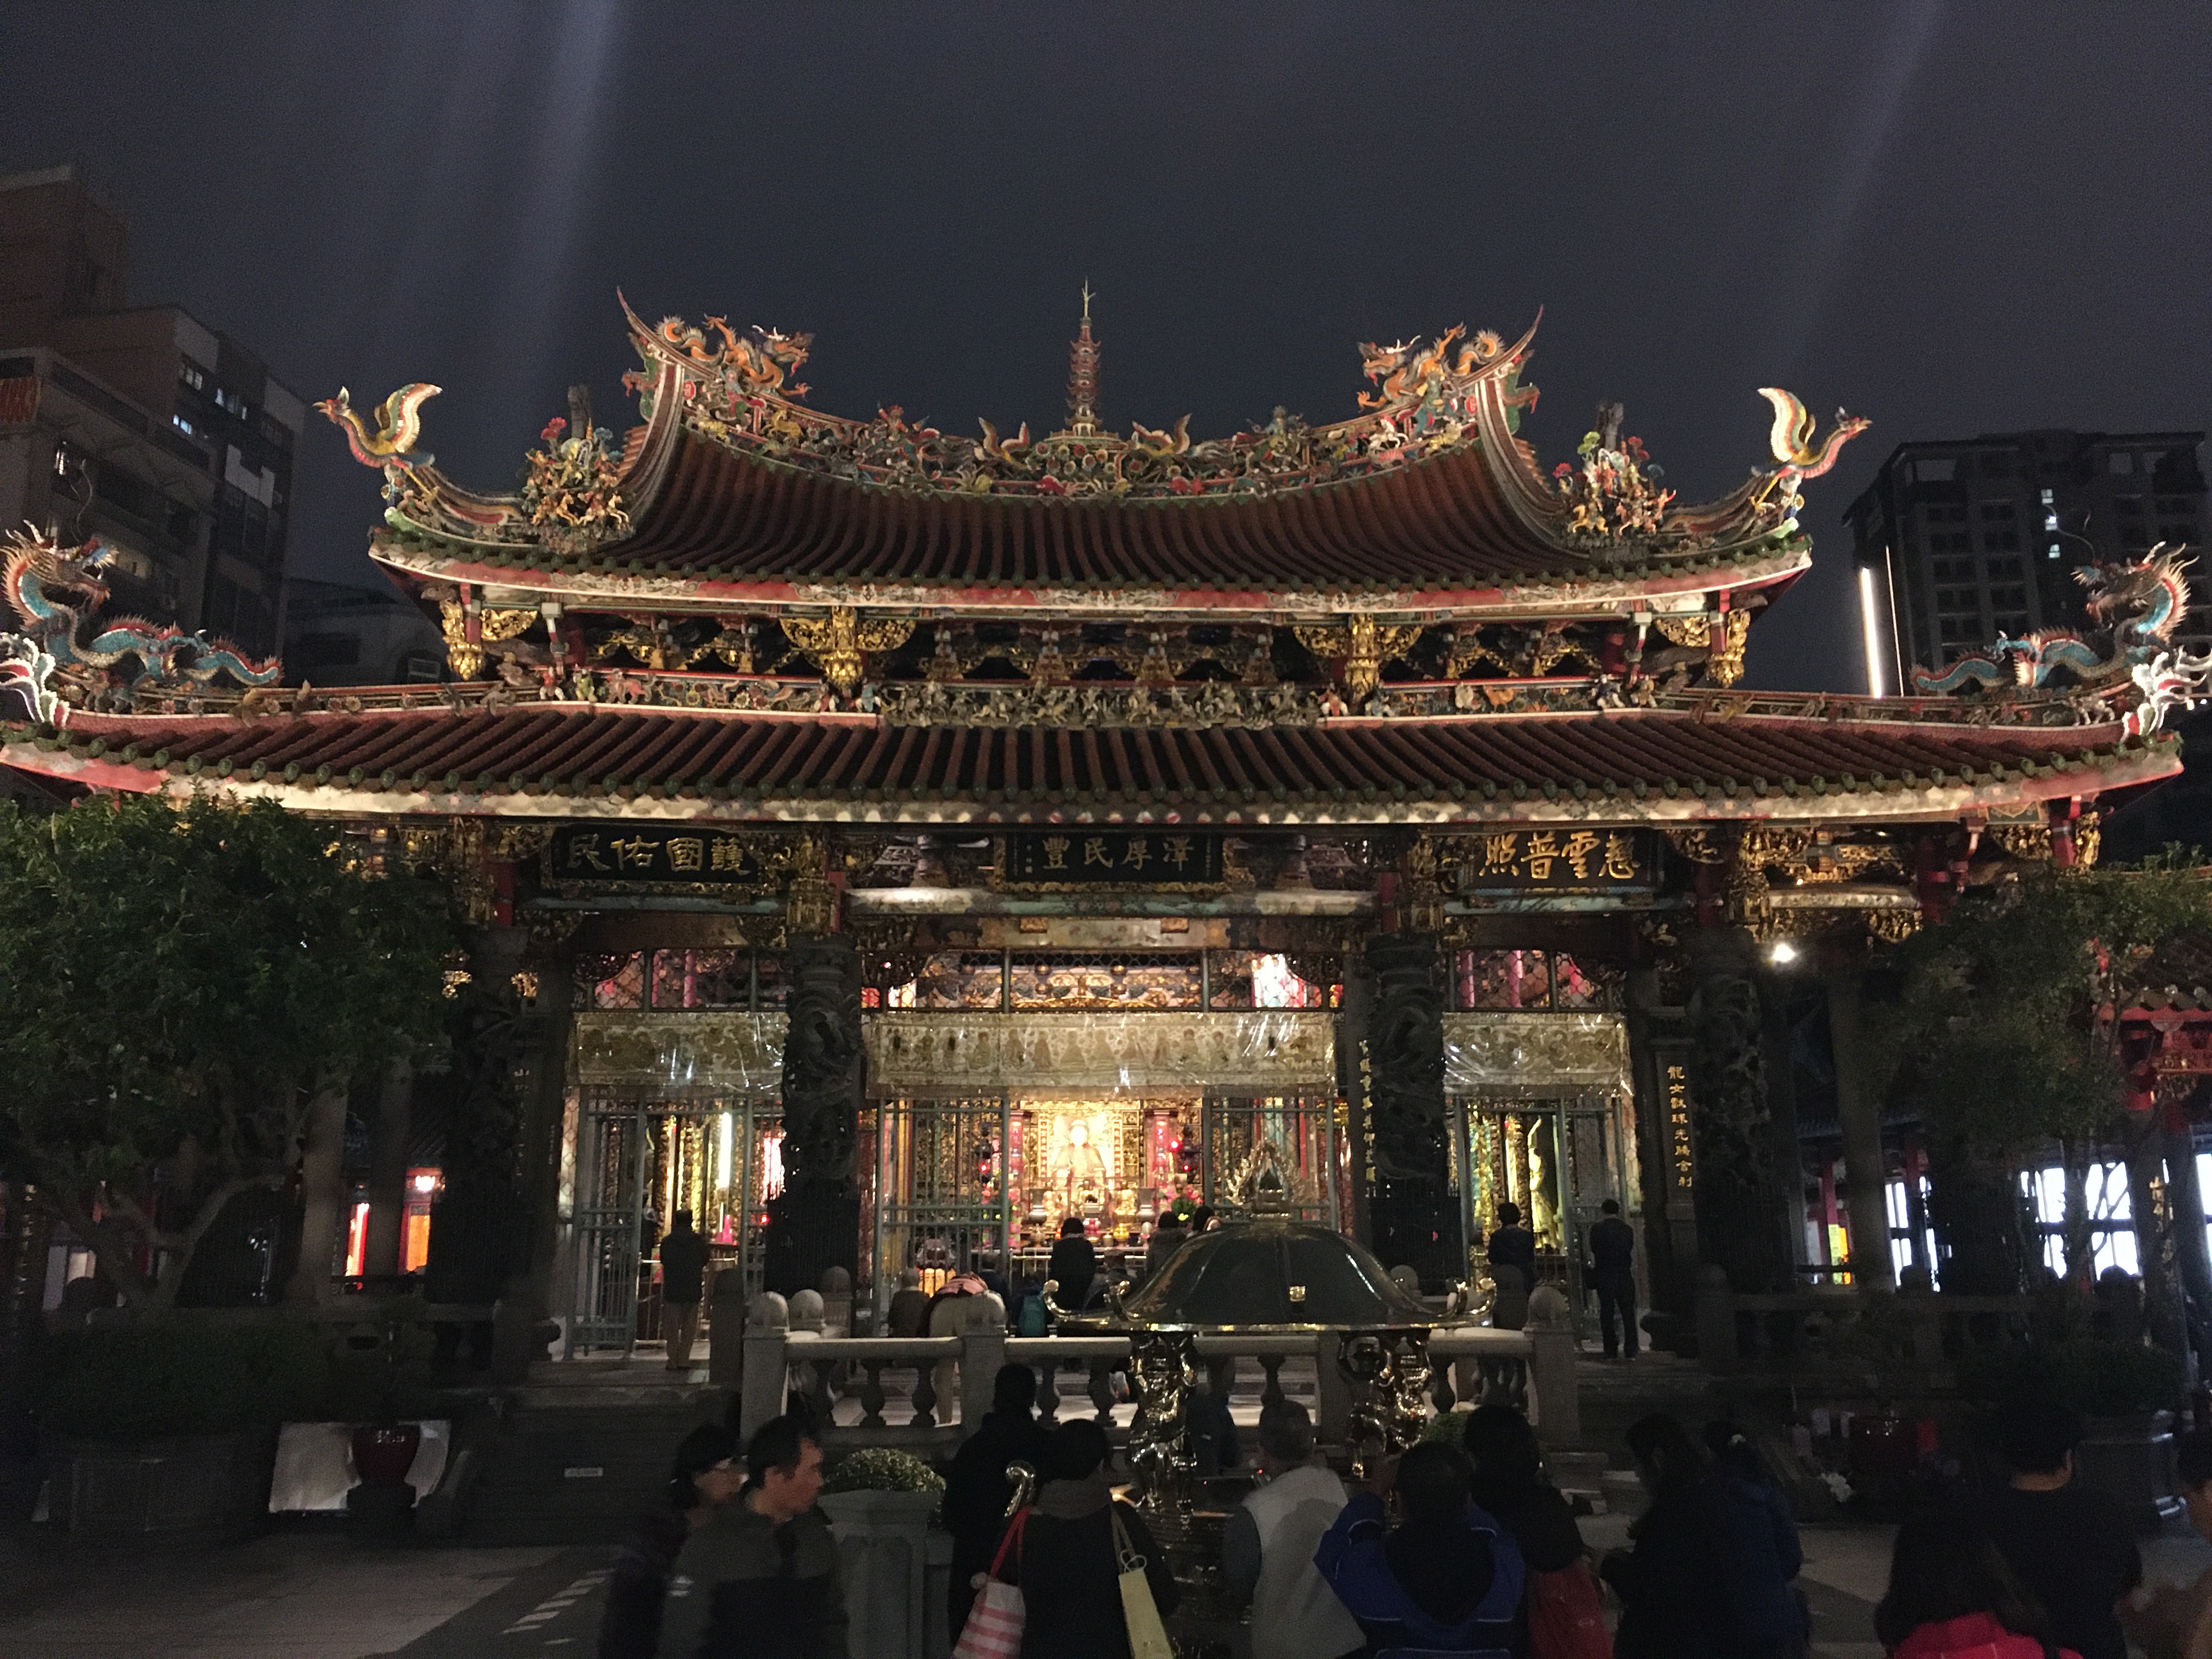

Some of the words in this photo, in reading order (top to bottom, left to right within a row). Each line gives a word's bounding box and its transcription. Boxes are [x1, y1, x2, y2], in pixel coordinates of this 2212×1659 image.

[566, 833, 751, 876] 護國佑民
[1043, 834, 1194, 872] 澤厚民豐
